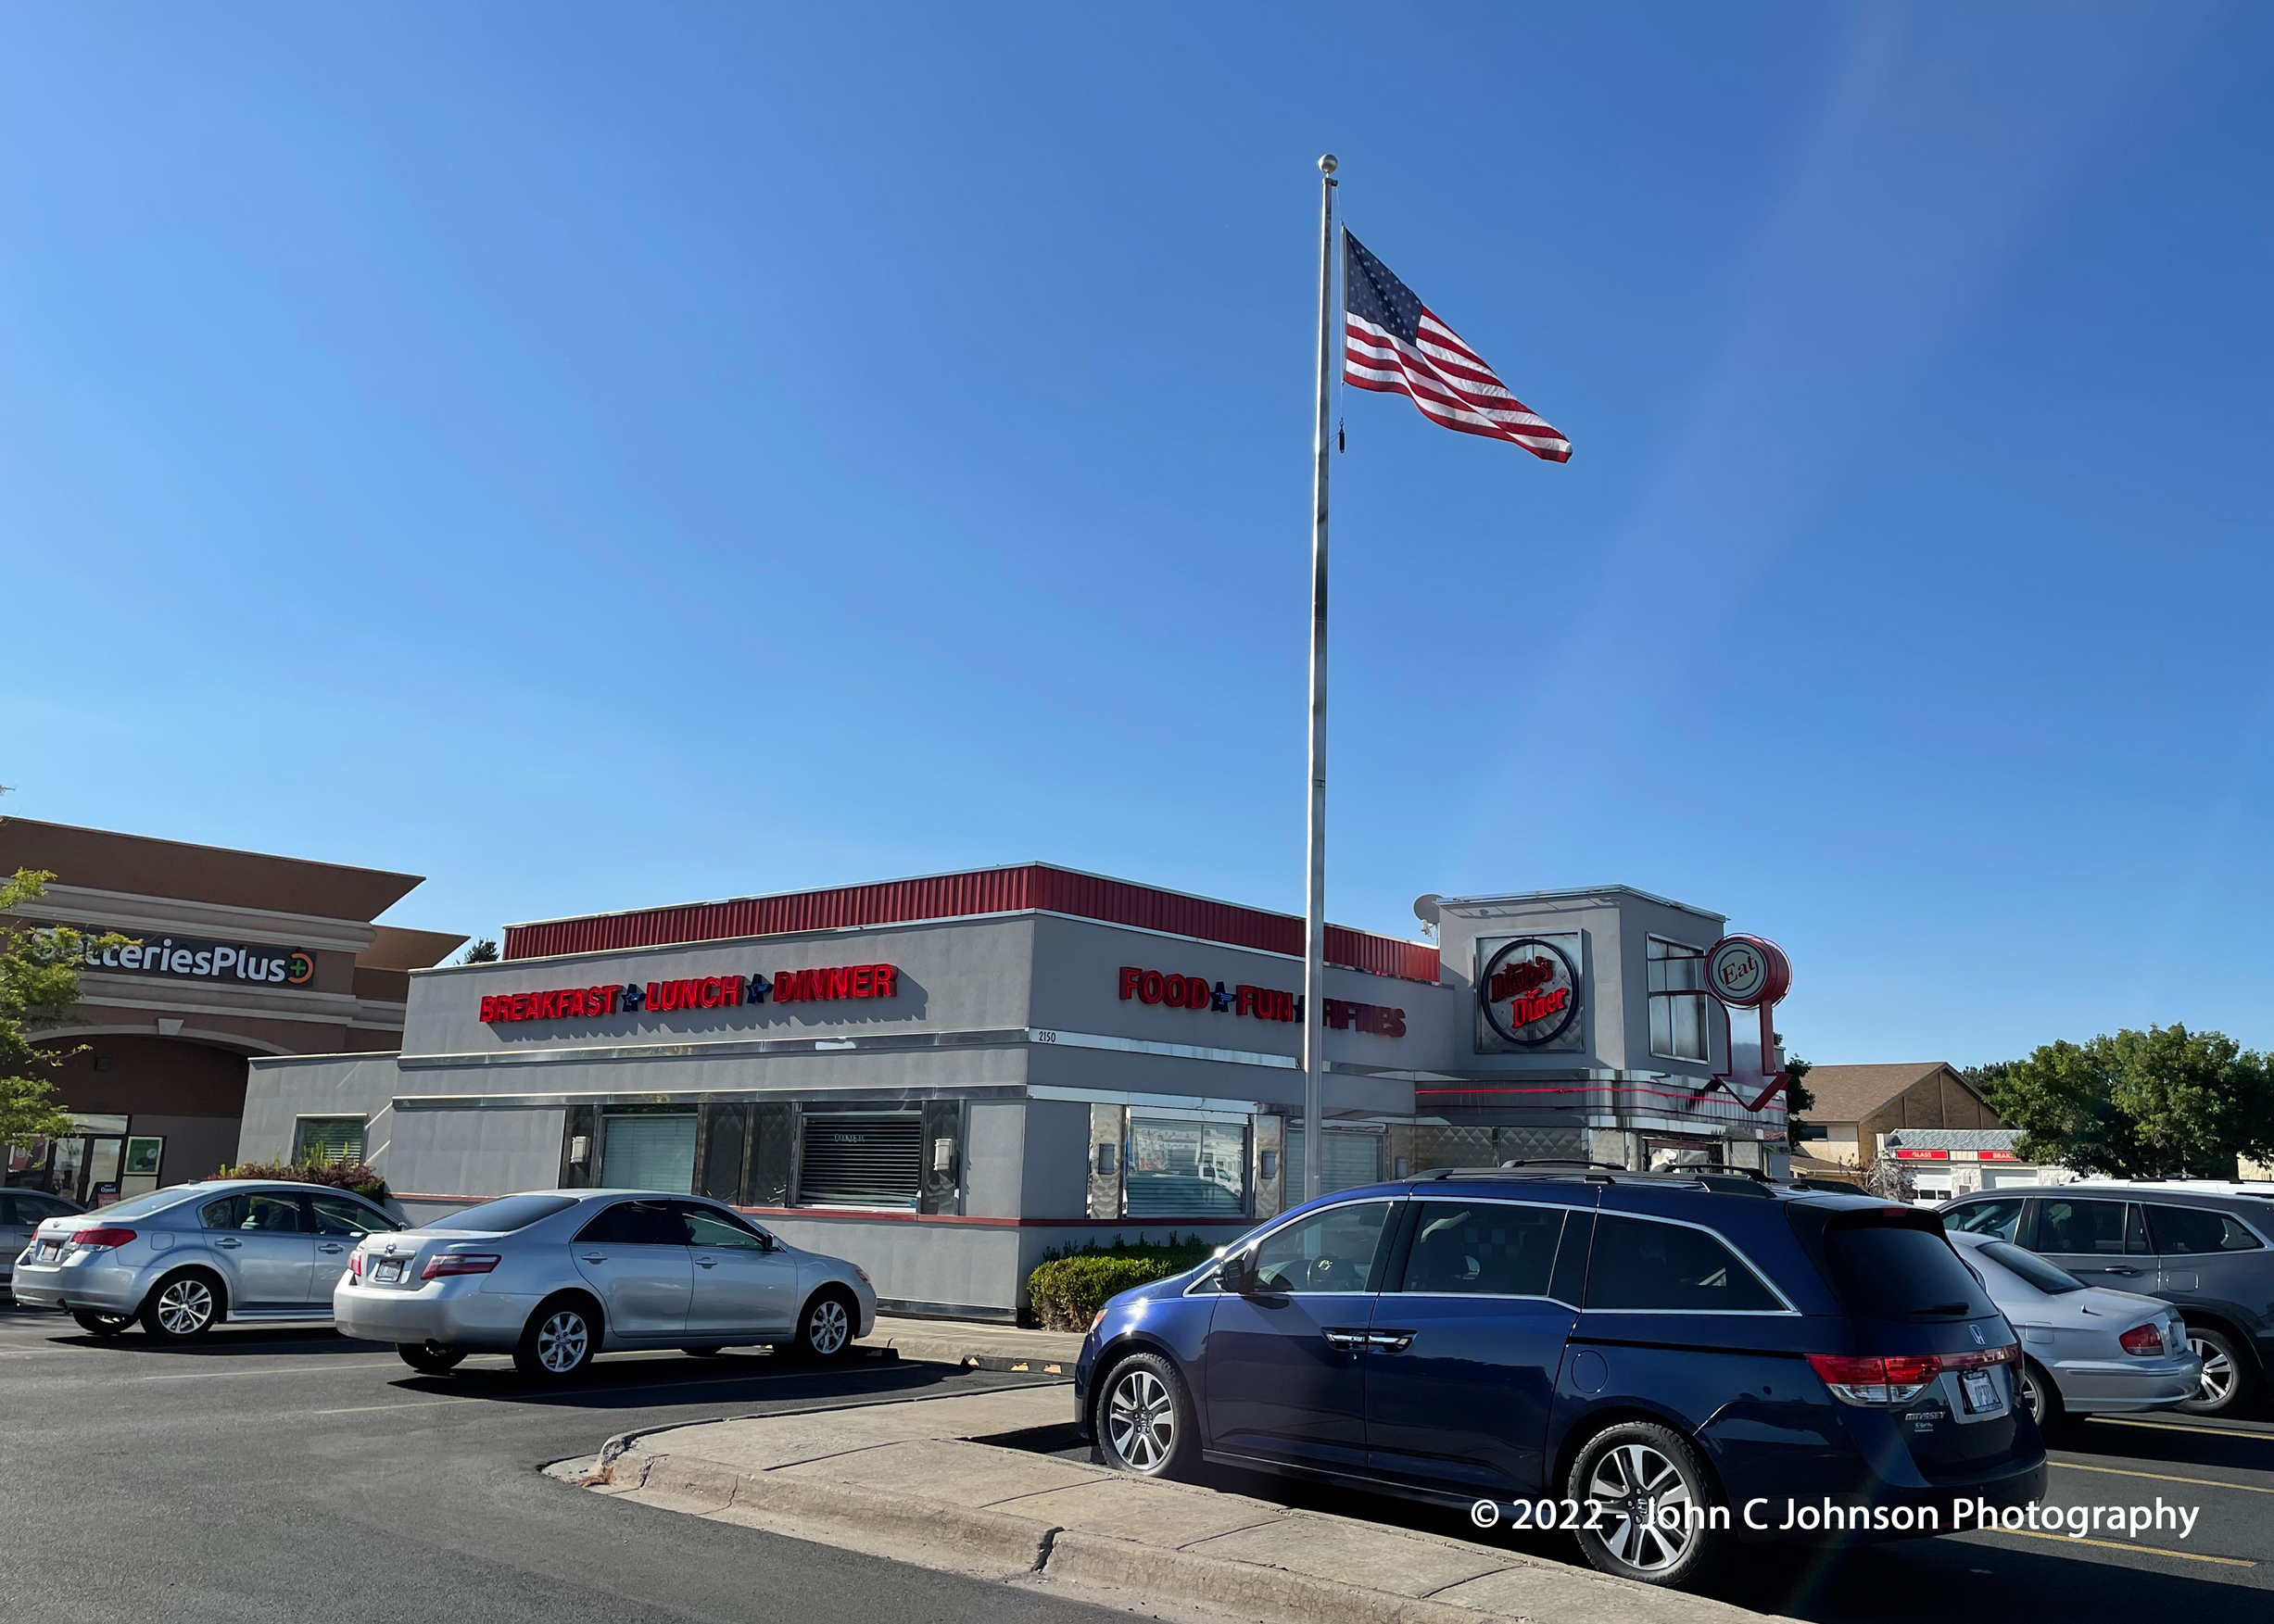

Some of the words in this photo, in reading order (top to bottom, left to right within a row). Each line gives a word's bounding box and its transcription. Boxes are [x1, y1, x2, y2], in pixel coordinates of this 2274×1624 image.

[1722, 955, 1756, 988] Eat
[479, 985, 623, 1023] BREAKFAST
[645, 976, 745, 1012] LUNCH
[773, 963, 898, 1002] DINNER
[1119, 967, 1210, 1010] FOOD
[1236, 985, 1294, 1022] FUN
[1510, 988, 1570, 1029] Diner
[1039, 1030, 1056, 1043] 2150
